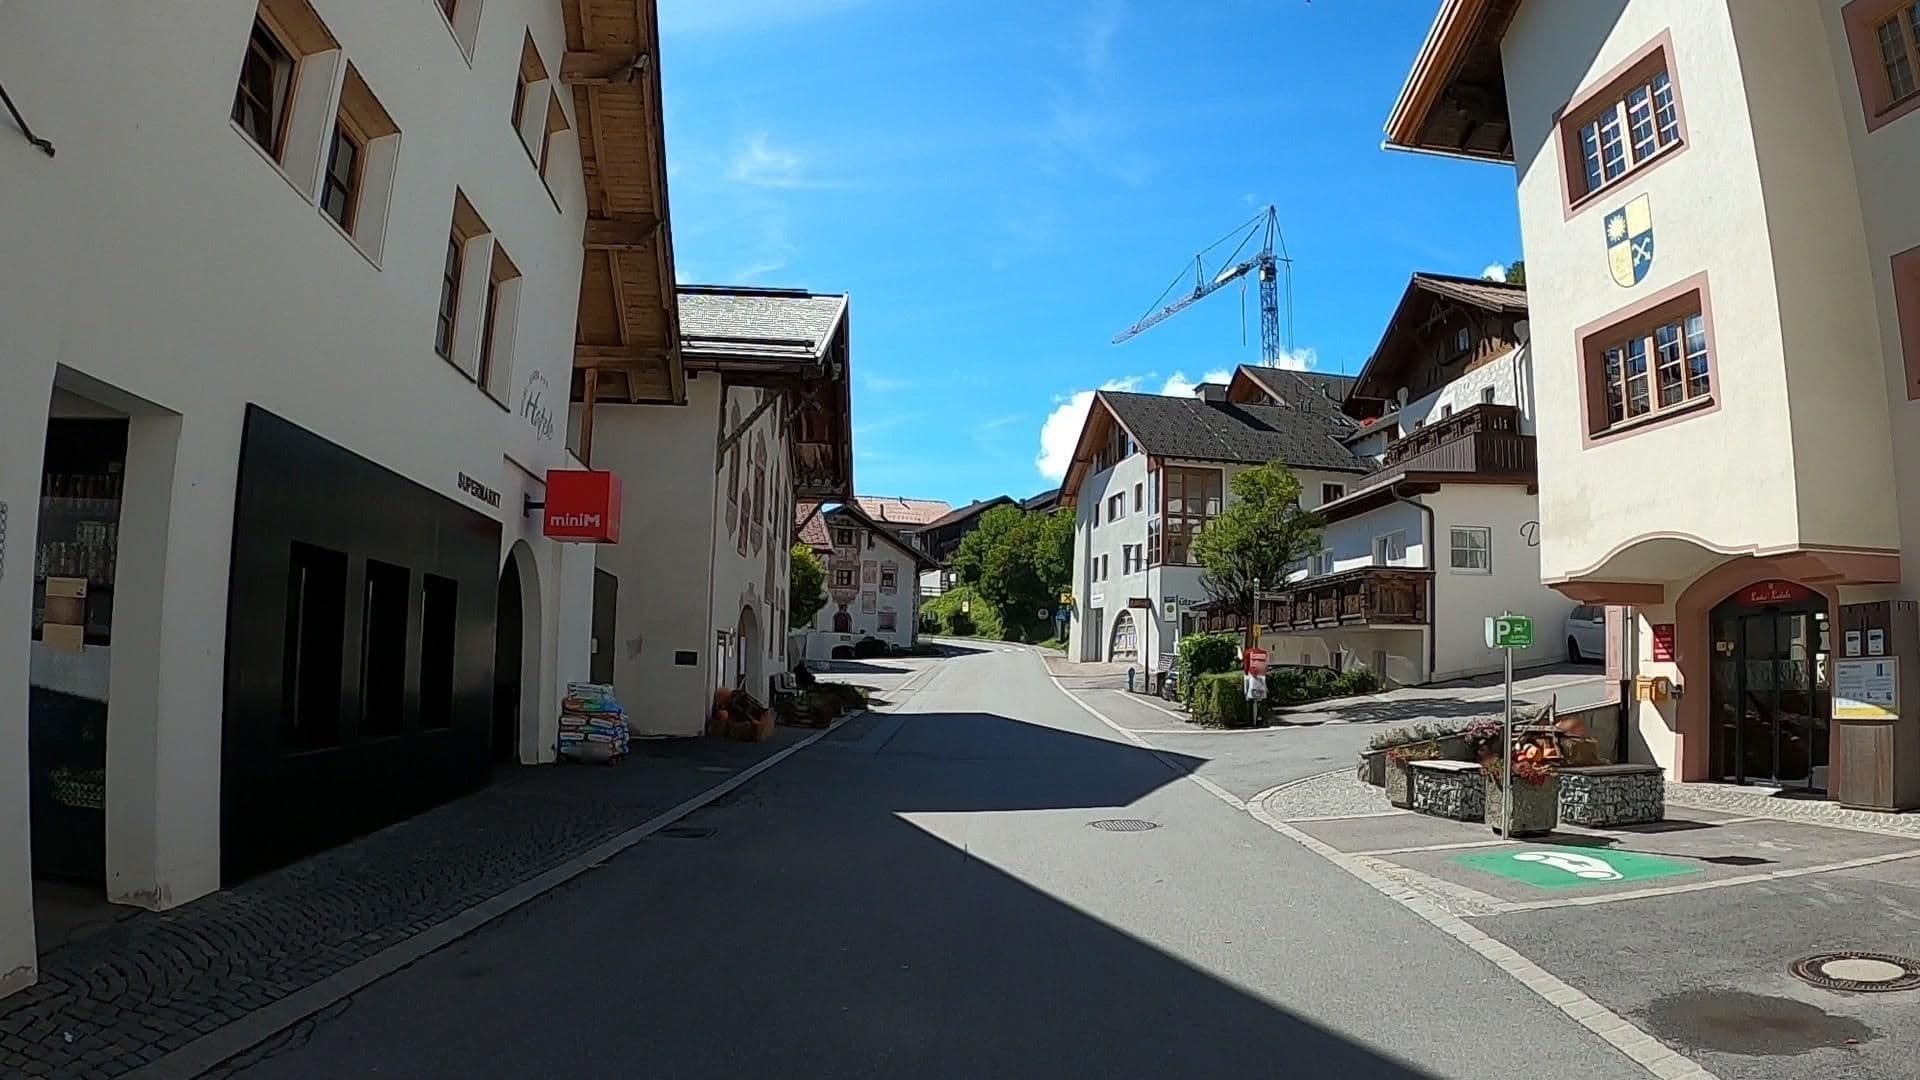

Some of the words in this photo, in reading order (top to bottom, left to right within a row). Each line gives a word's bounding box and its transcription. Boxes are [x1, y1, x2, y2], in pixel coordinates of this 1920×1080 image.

[458, 471, 501, 509] SUPERMARKT
[550, 512, 600, 528] miniM
[1496, 620, 1511, 644] P
